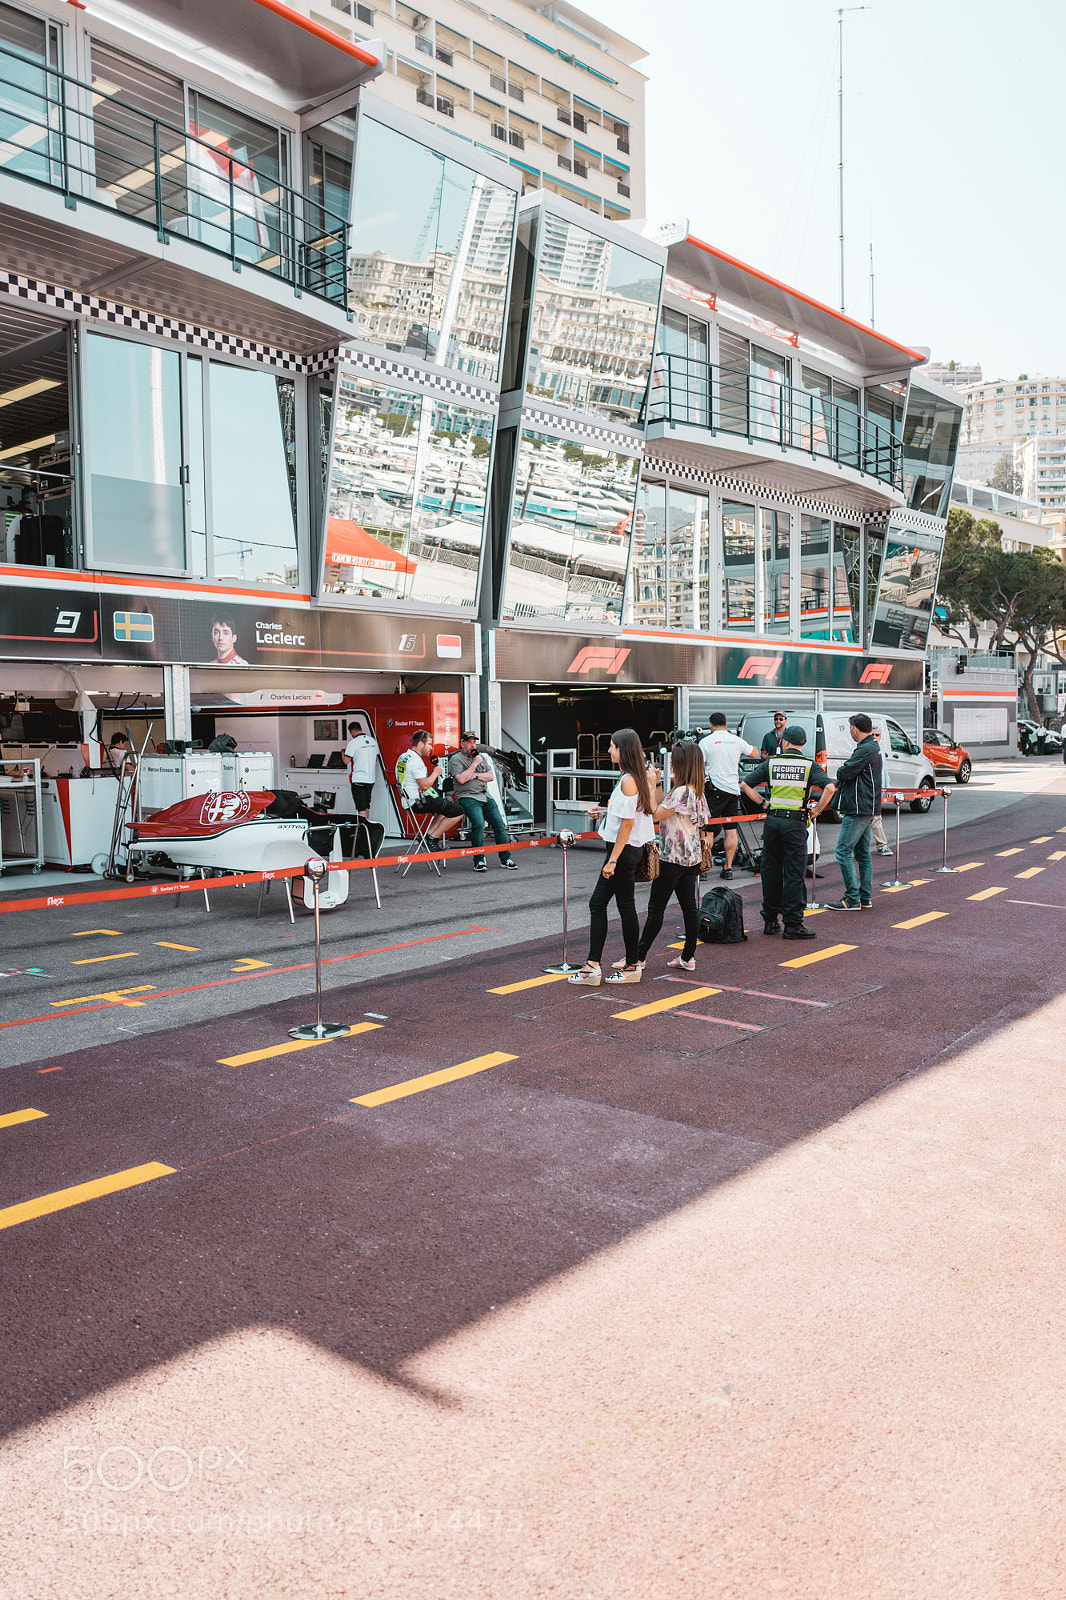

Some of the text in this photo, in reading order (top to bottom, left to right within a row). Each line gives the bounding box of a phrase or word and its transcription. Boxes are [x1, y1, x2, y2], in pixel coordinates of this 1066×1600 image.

[54, 610, 82, 634] 9
[255, 621, 283, 630] Charles
[255, 630, 305, 646] Leclerc
[398, 633, 416, 652] 16
[772, 765, 805, 774] SECURITE
[46, 896, 64, 906] flex
